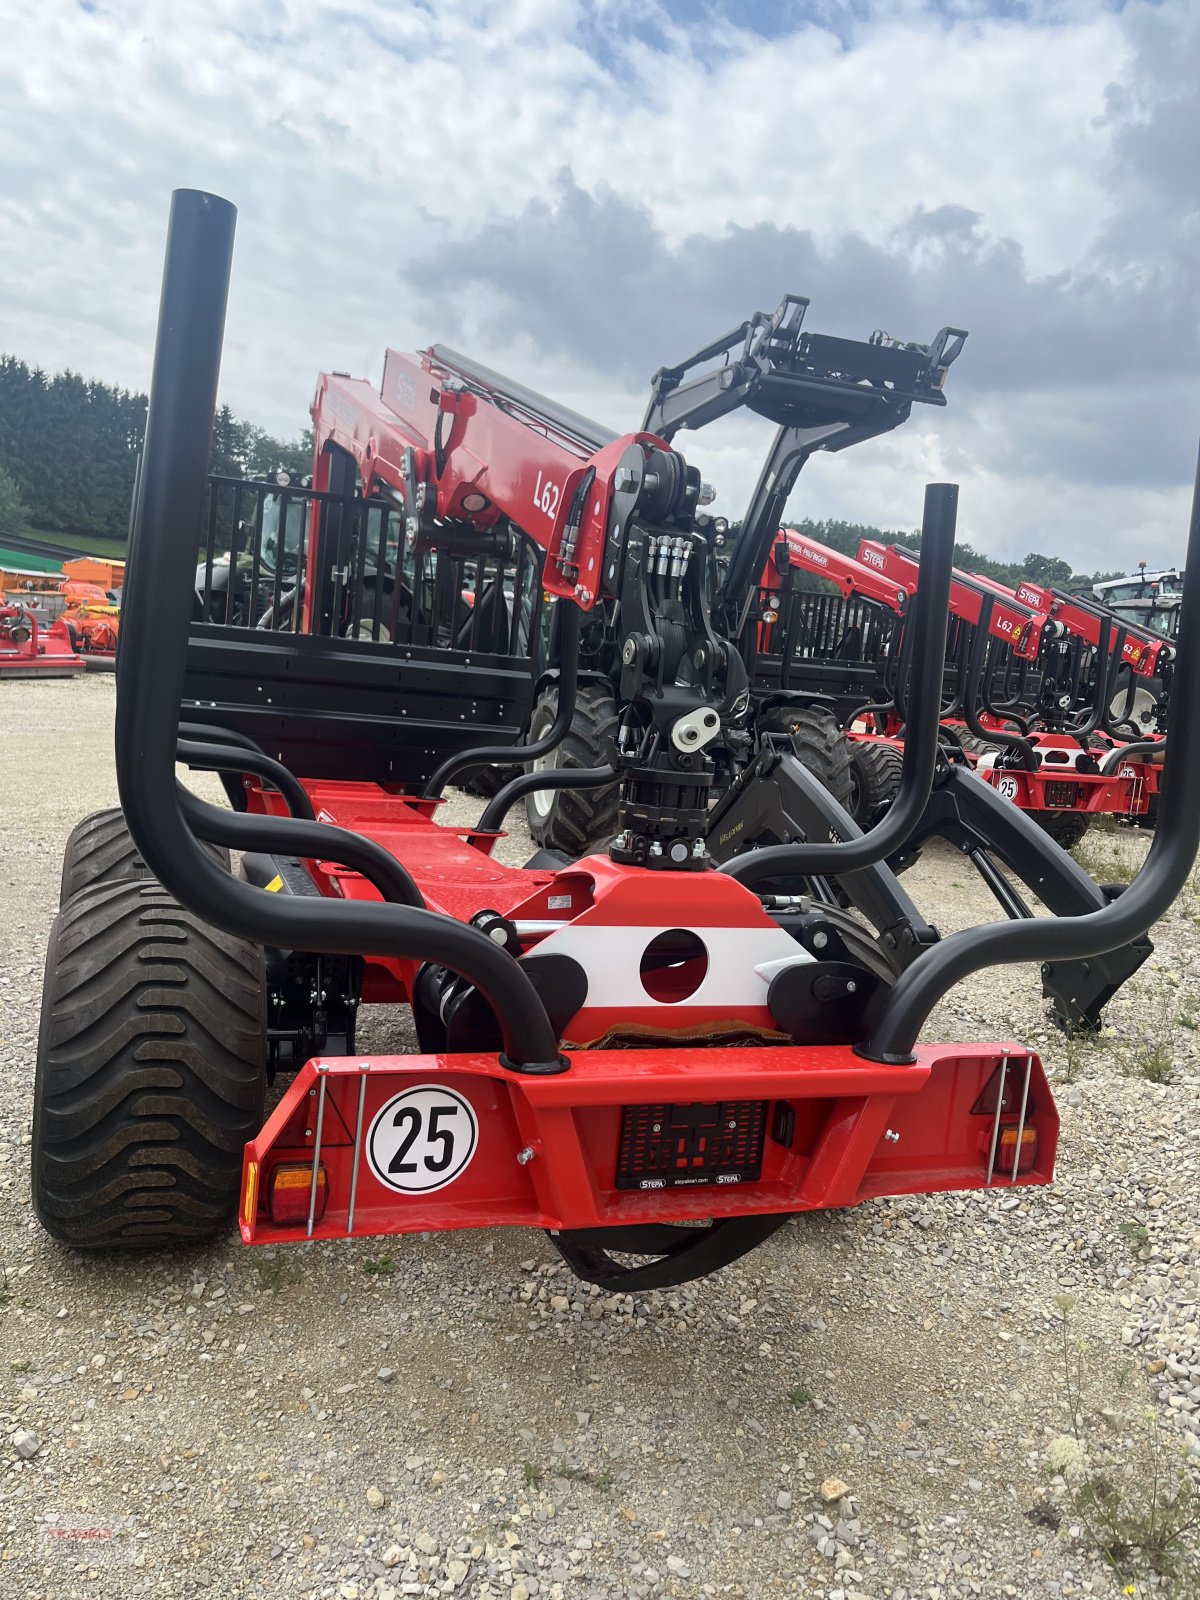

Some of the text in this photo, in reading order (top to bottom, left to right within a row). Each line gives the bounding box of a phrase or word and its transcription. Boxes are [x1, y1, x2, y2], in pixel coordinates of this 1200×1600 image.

[534, 470, 559, 520] L62
[788, 541, 828, 567] TEINDL-PALFINGER
[863, 548, 884, 569] STEPA
[1019, 588, 1040, 607] STEPA
[997, 616, 1012, 633] L62
[1123, 644, 1132, 654] 62
[1002, 782, 1014, 797] 25
[388, 1106, 458, 1174] 25
[642, 1174, 739, 1189] STEPA stepakran.com STEPA
